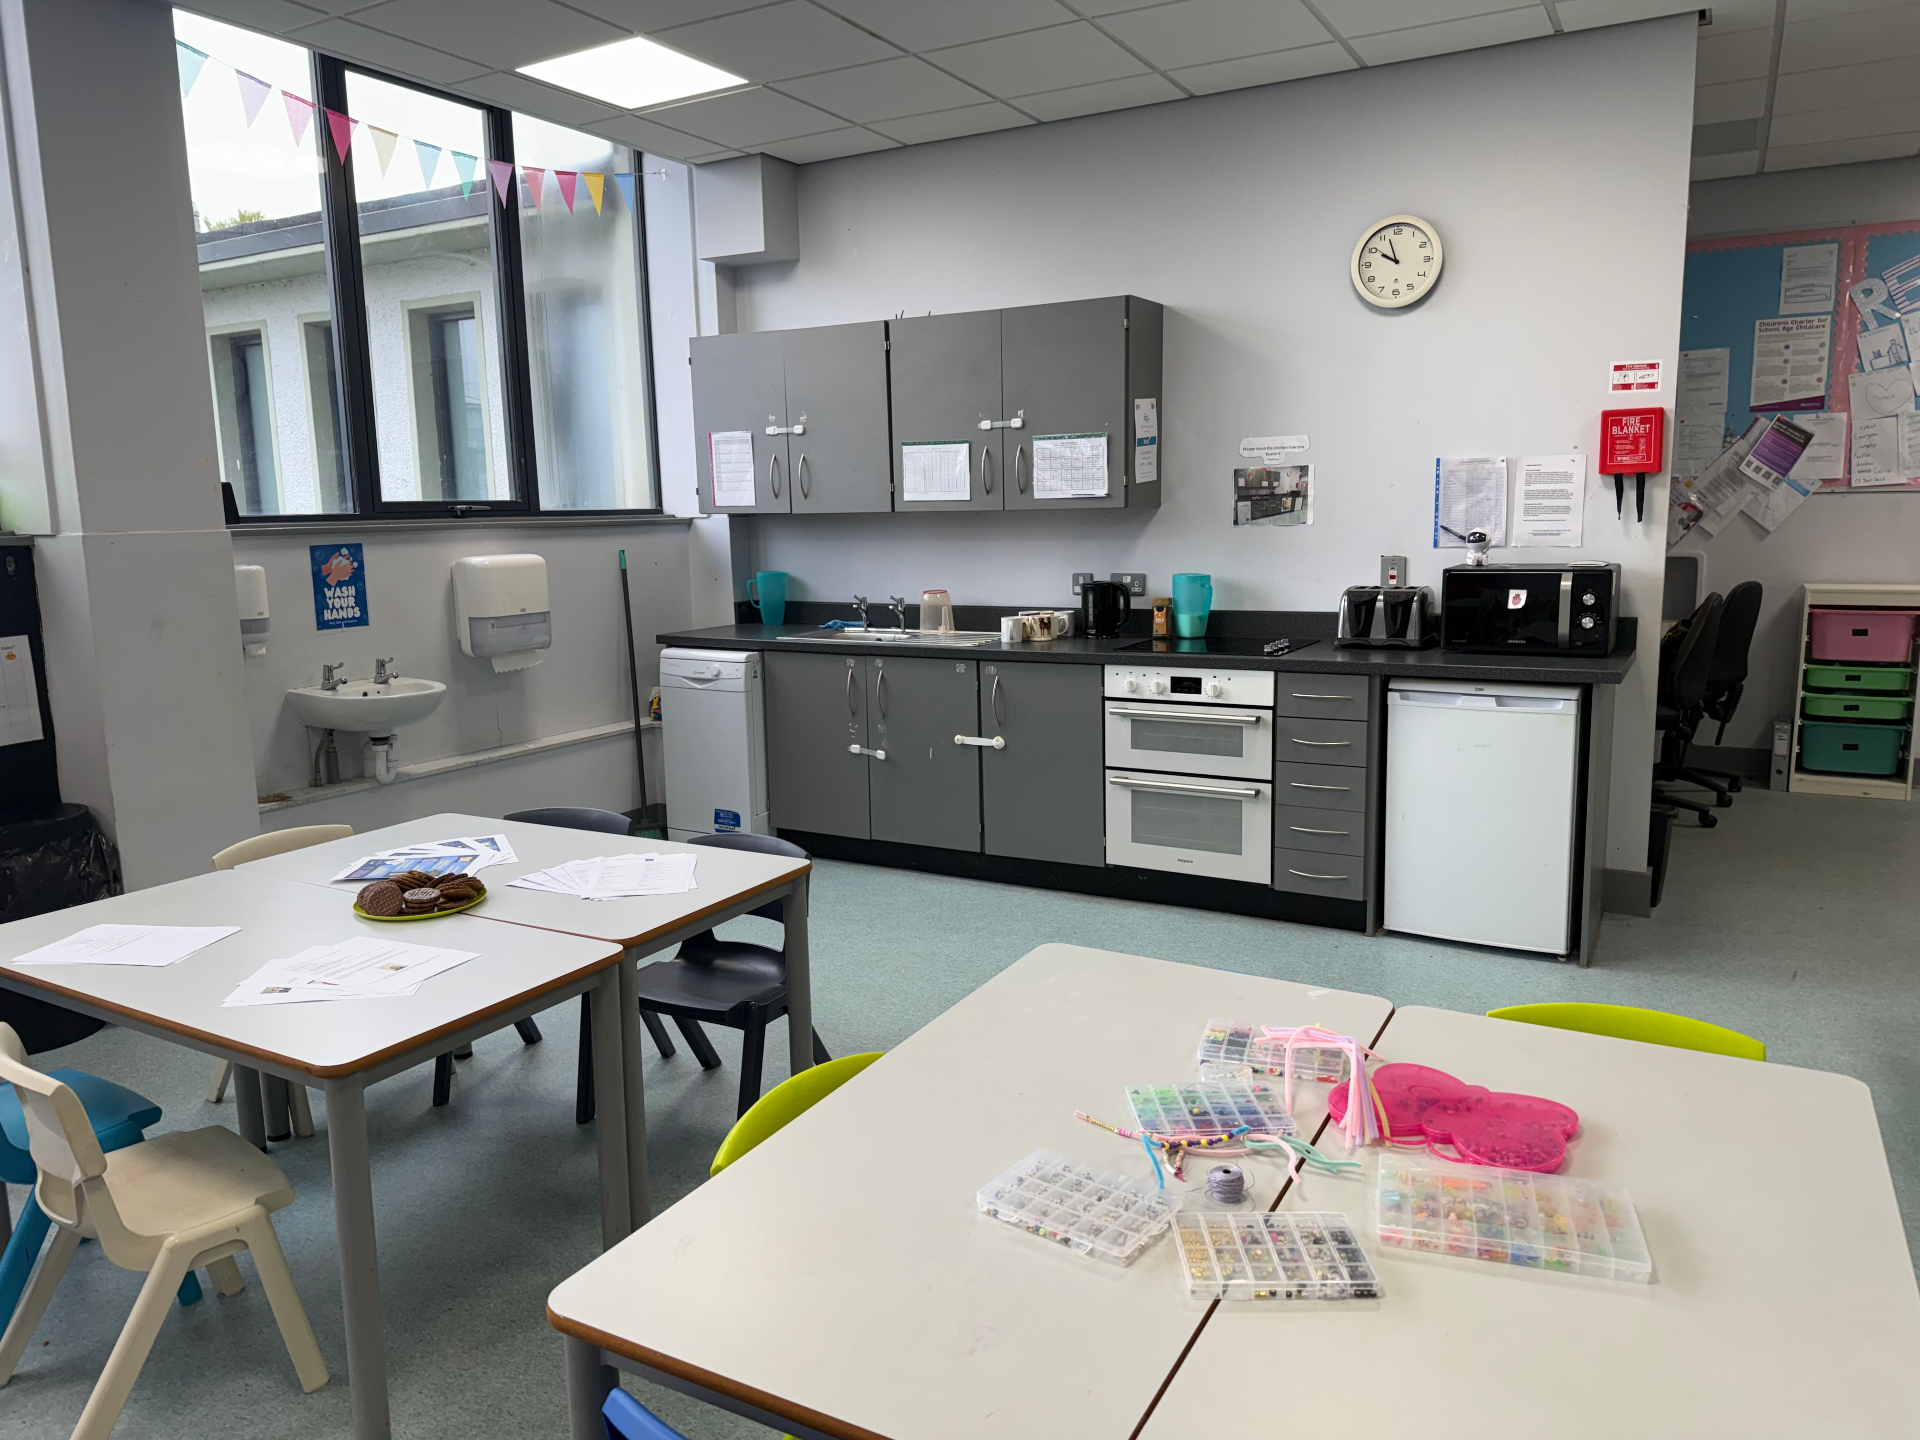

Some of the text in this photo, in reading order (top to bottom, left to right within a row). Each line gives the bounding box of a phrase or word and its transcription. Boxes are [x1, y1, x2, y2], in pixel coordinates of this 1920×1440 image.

[1622, 417, 1640, 426] FIRE
[1612, 424, 1650, 434] BLANKET
[324, 586, 356, 598] WASH
[326, 597, 356, 609] YOUR
[324, 607, 360, 620] HANDS
